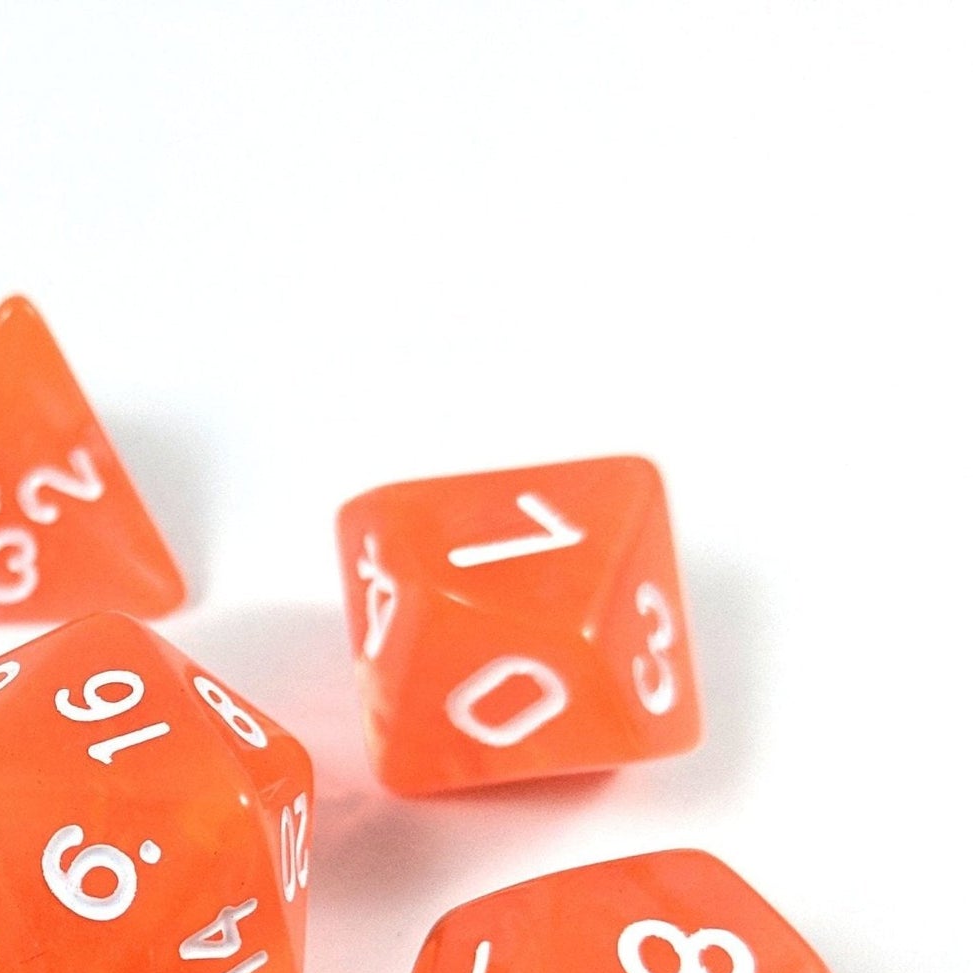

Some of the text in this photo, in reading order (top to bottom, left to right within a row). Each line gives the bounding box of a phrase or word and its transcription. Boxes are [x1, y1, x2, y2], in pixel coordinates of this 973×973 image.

[16, 445, 104, 524] 2
[356, 531, 399, 661] 4
[632, 581, 676, 715] 3
[193, 676, 268, 748] 8
[445, 654, 568, 748] 0
[280, 792, 309, 902] 20
